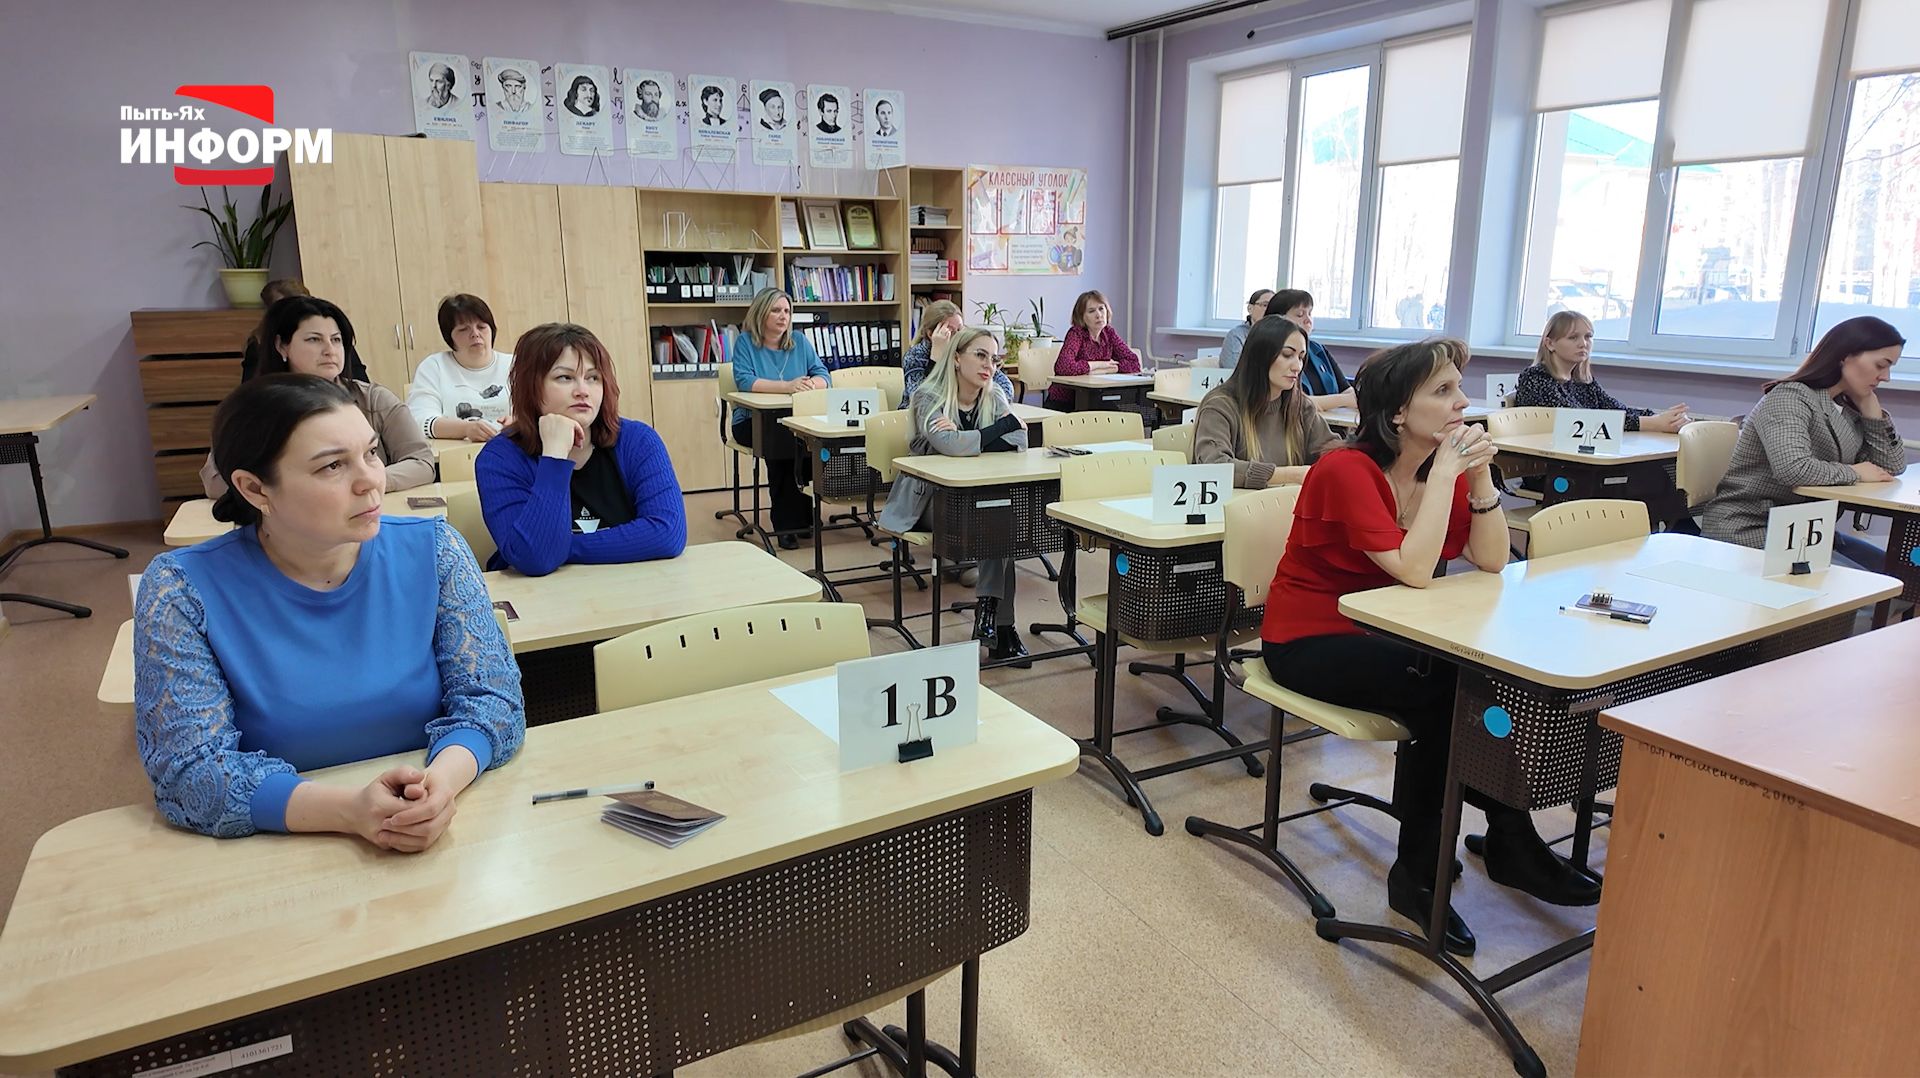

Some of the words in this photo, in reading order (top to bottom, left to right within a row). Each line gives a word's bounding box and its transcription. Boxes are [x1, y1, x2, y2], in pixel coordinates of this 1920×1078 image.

[988, 171, 1035, 187] КЛАССНЫЙ
[1038, 173, 1069, 188] УГОЛОК
[1201, 376, 1209, 389] 4
[1496, 382, 1505, 398] 3
[840, 399, 851, 415] 4
[857, 400, 870, 415] Б
[1571, 420, 1585, 438] 2
[1593, 421, 1612, 440] А
[1172, 481, 1188, 506] 2
[1198, 480, 1219, 505] Б
[1784, 521, 1796, 551] 1
[1805, 517, 1824, 547] Б
[880, 682, 903, 729] 1
[922, 675, 957, 721] В
